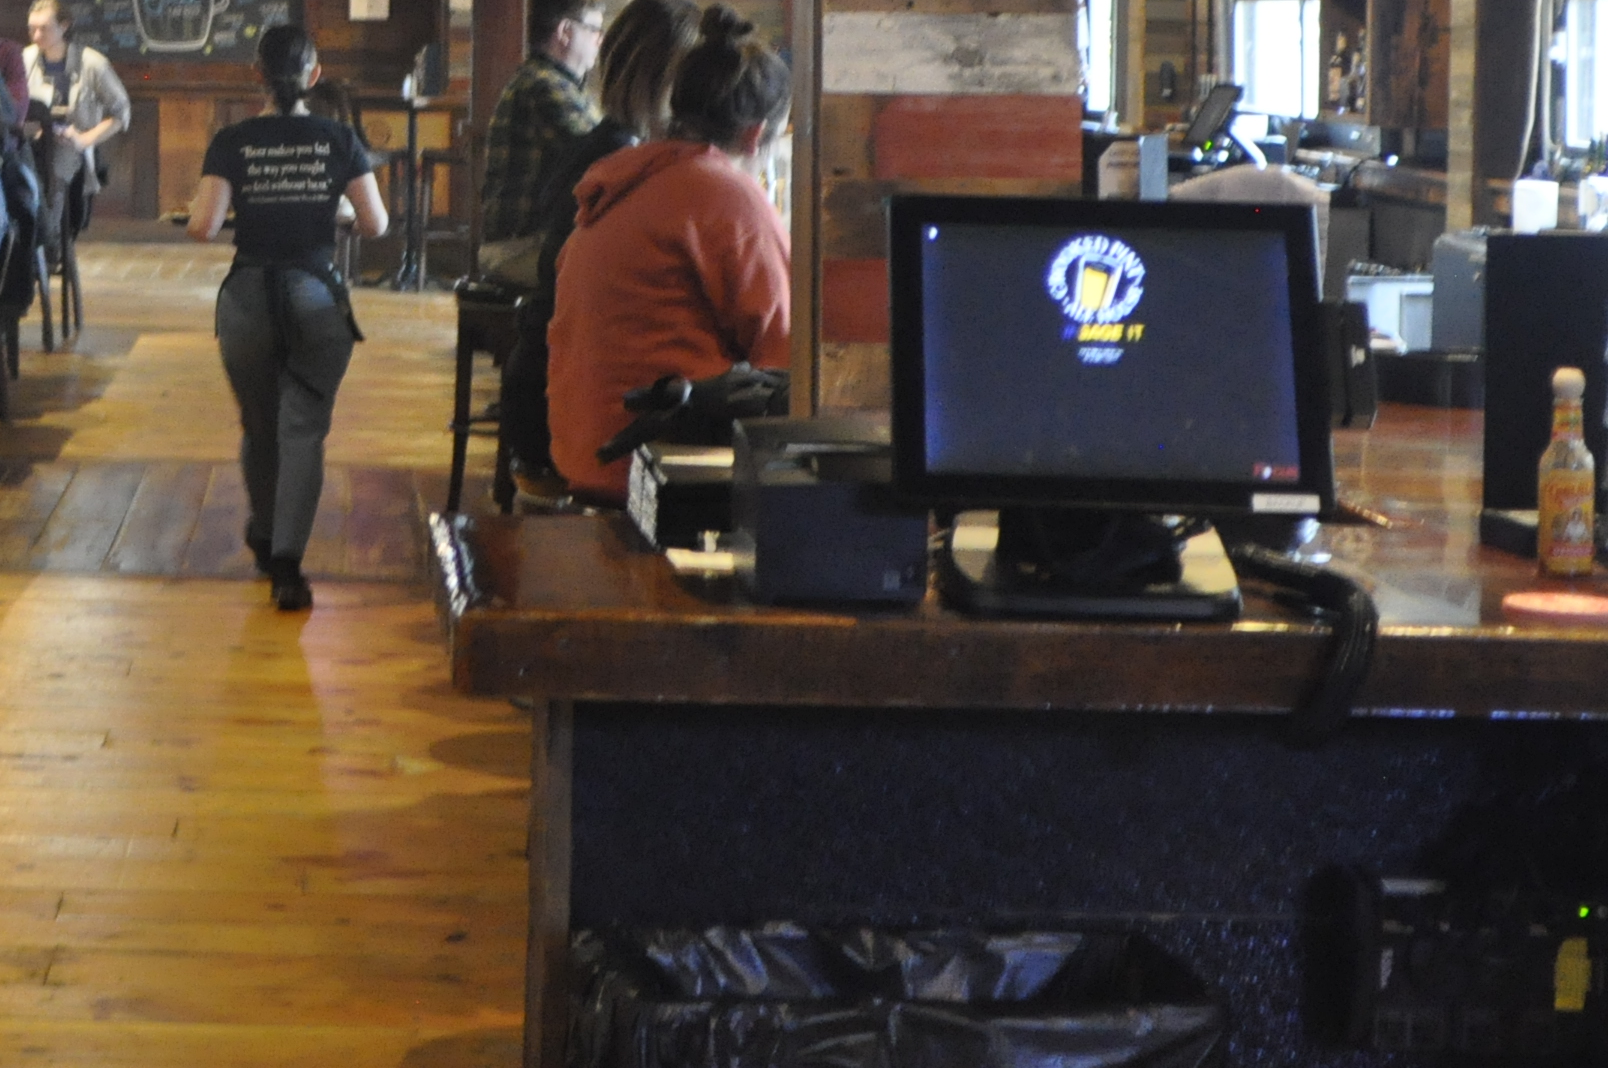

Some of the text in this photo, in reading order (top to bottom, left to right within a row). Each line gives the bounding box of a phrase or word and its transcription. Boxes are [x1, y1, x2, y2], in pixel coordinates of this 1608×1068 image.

[268, 143, 296, 158] makes
[296, 145, 313, 159] you
[248, 160, 325, 179] the way you ought
[272, 178, 306, 191] without
